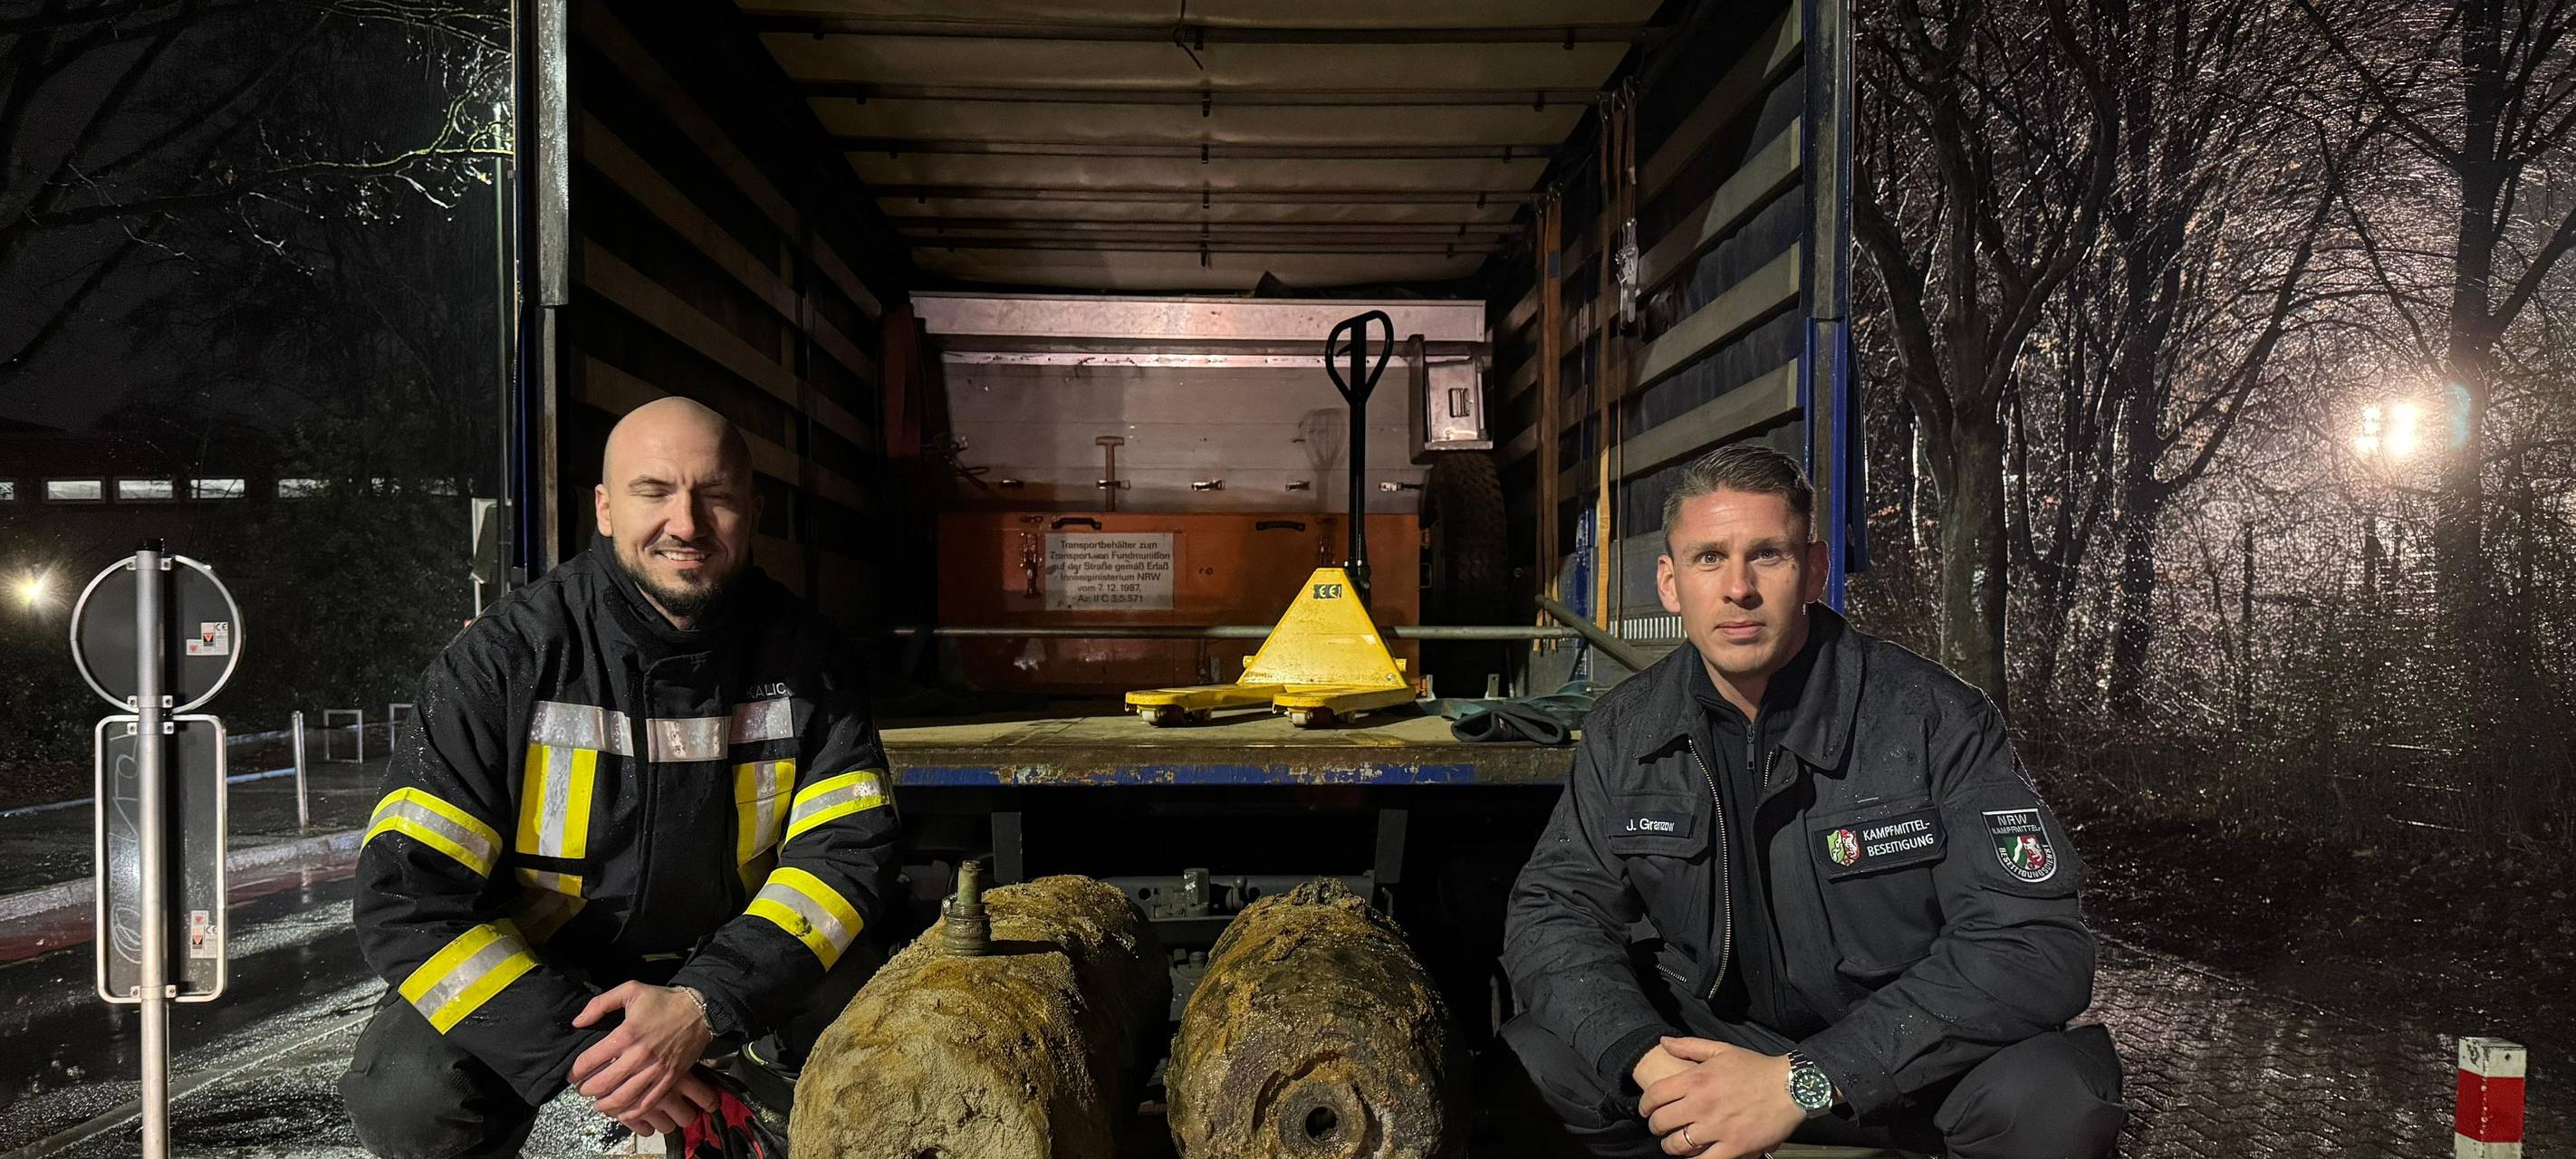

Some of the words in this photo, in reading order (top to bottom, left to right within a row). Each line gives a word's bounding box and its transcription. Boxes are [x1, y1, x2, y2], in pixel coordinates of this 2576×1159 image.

[1061, 540, 1136, 551] Transportbehälter
[1139, 541, 1158, 550] zum
[1067, 561, 1081, 570] der
[1083, 560, 1112, 570] Straße
[1060, 572, 1135, 582] Innenministerium
[1137, 572, 1161, 580] NRW
[1997, 813, 2028, 826] NRW
[1862, 819, 1930, 841] KAMPFMITTEL-
[1867, 833, 1935, 857] BESEITIGUNG
